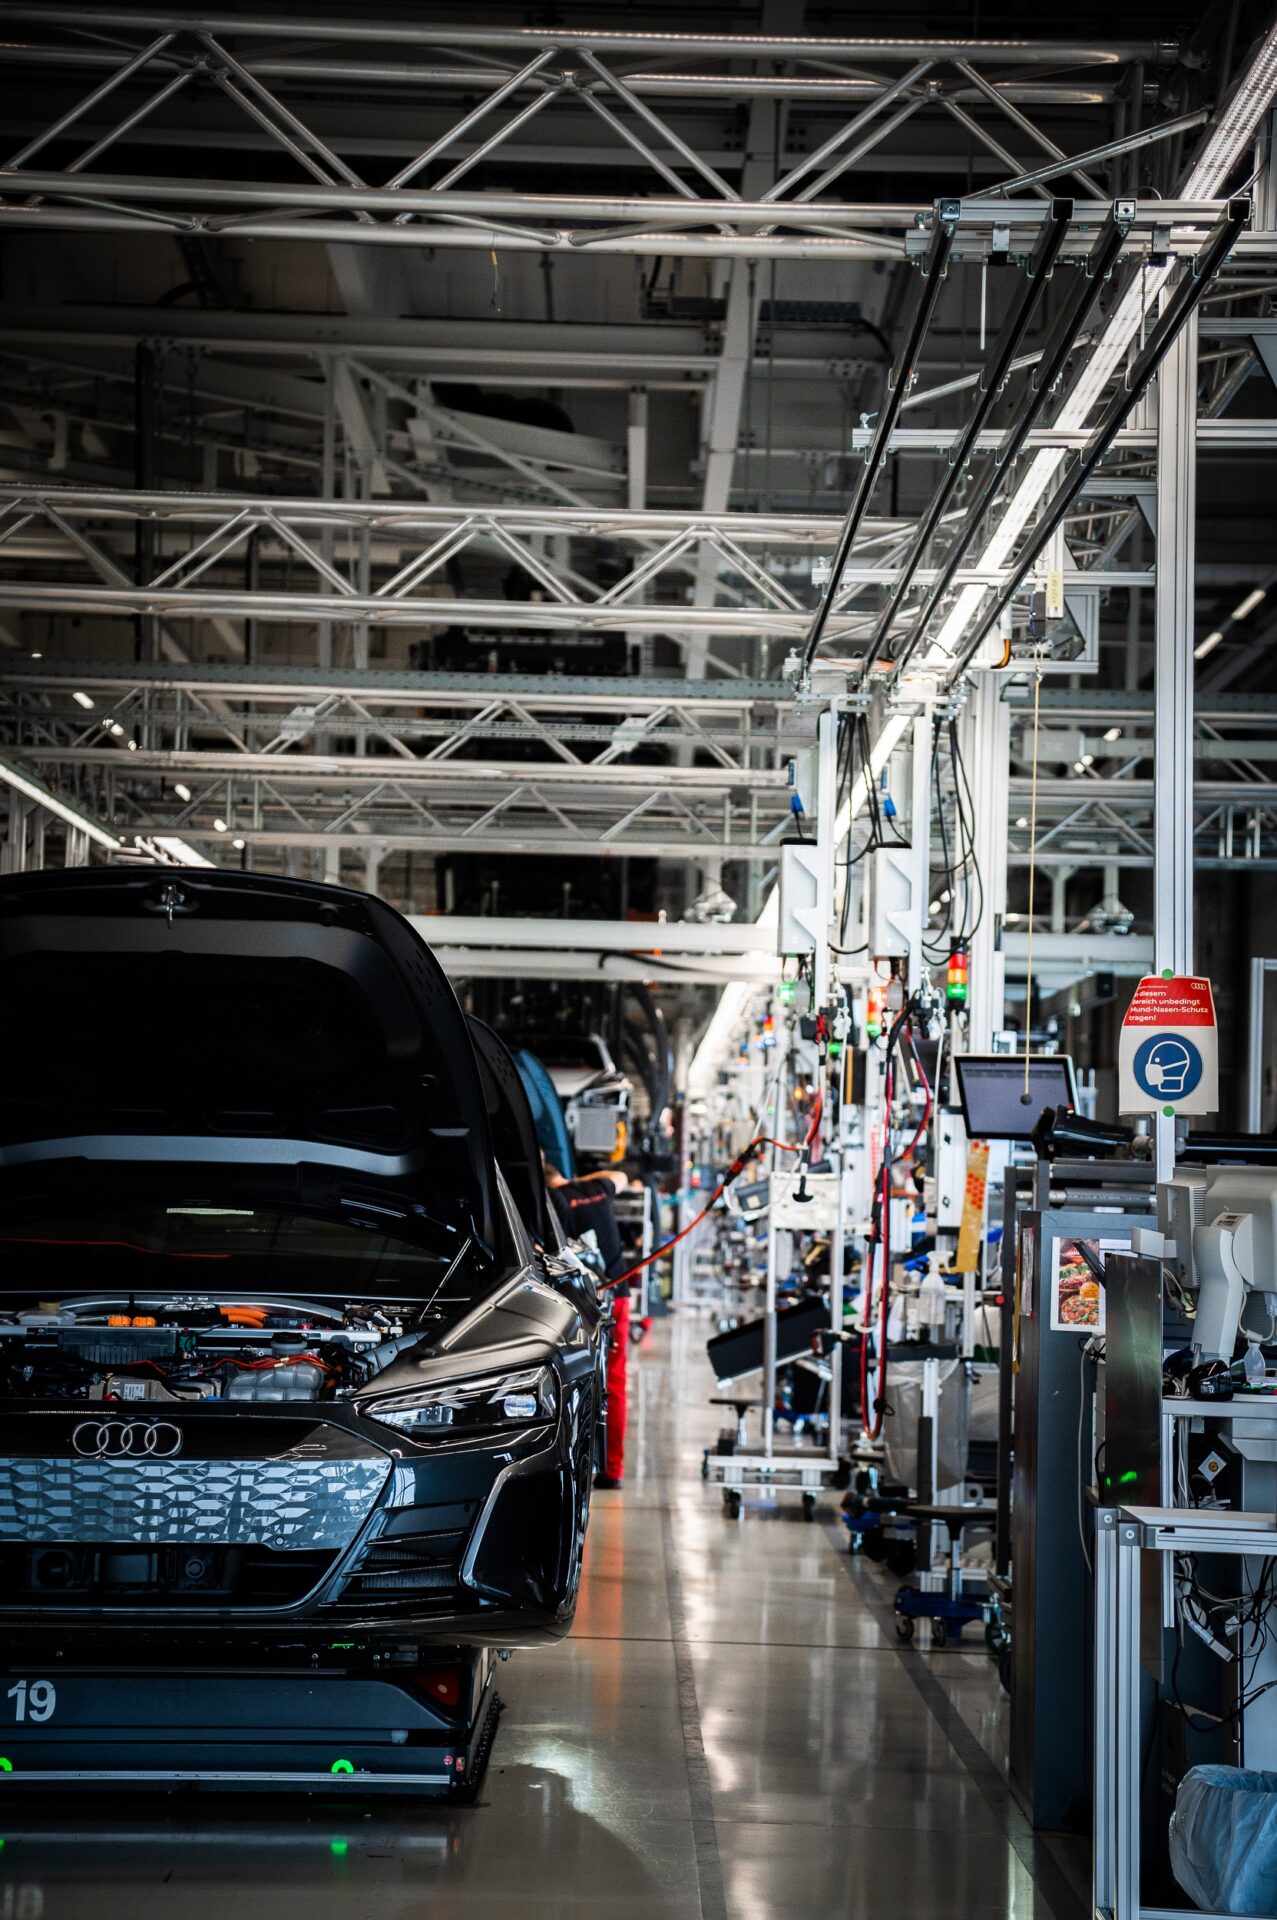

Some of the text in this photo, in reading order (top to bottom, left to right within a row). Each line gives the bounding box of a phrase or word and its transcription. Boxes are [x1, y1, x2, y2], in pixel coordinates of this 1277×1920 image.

[1159, 998, 1200, 1006] unbedingt
[1129, 1014, 1157, 1022] tragen!
[8, 1680, 56, 1721] 19
